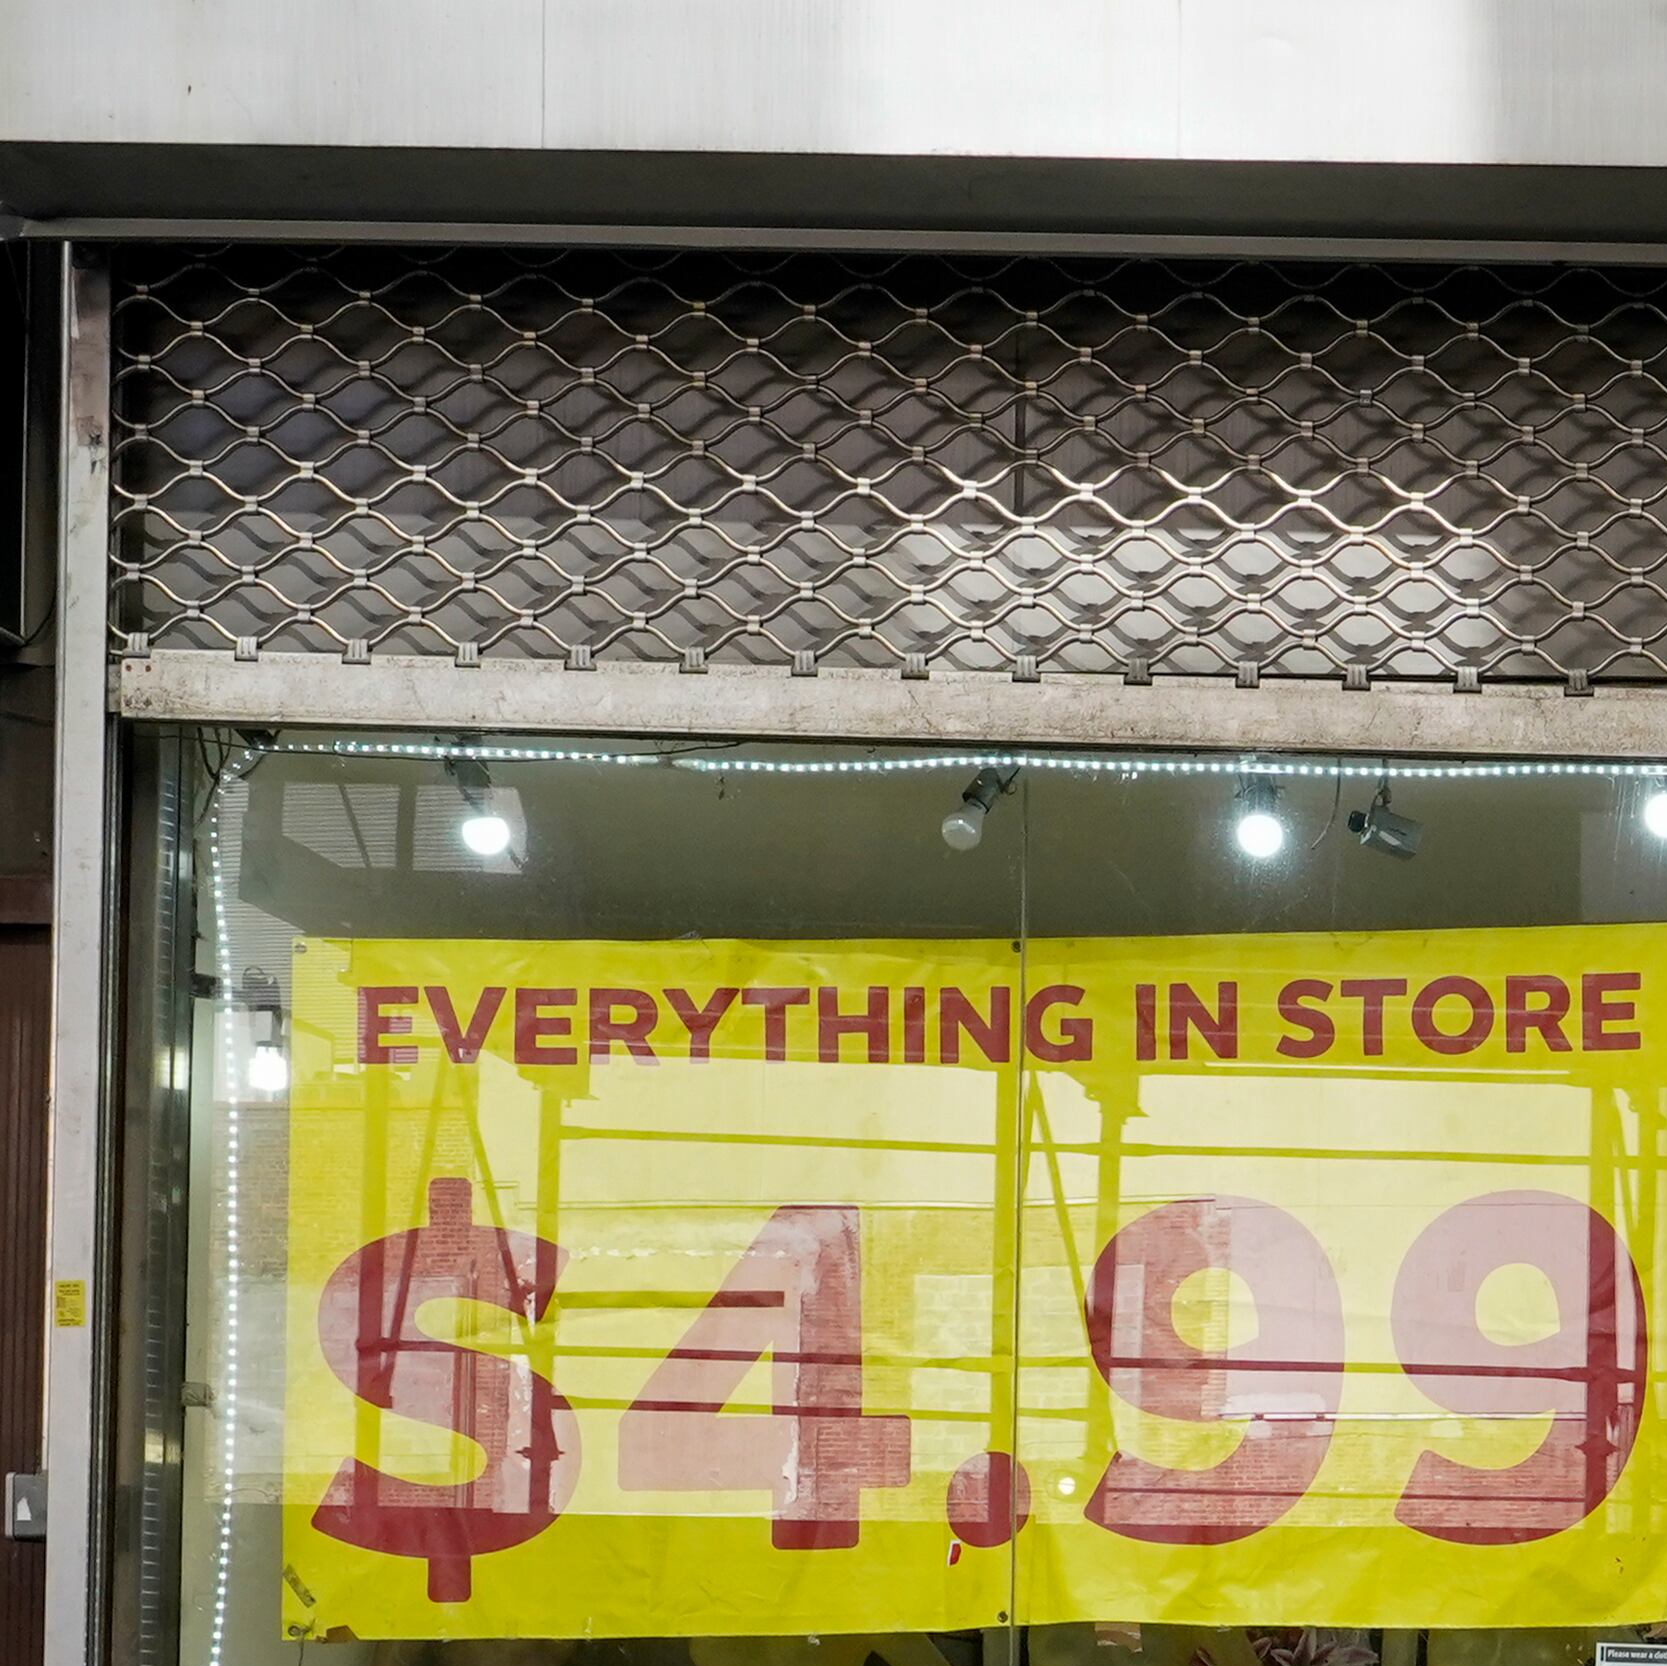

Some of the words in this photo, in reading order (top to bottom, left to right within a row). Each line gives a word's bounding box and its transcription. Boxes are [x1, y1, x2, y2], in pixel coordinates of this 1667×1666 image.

[357, 985, 1093, 1066] EVERYTHING
[1137, 981, 1238, 1060] IN
[1277, 971, 1643, 1059] STORE
[310, 1177, 1649, 1603] $4.99
[1607, 1649, 1630, 1658] Please
